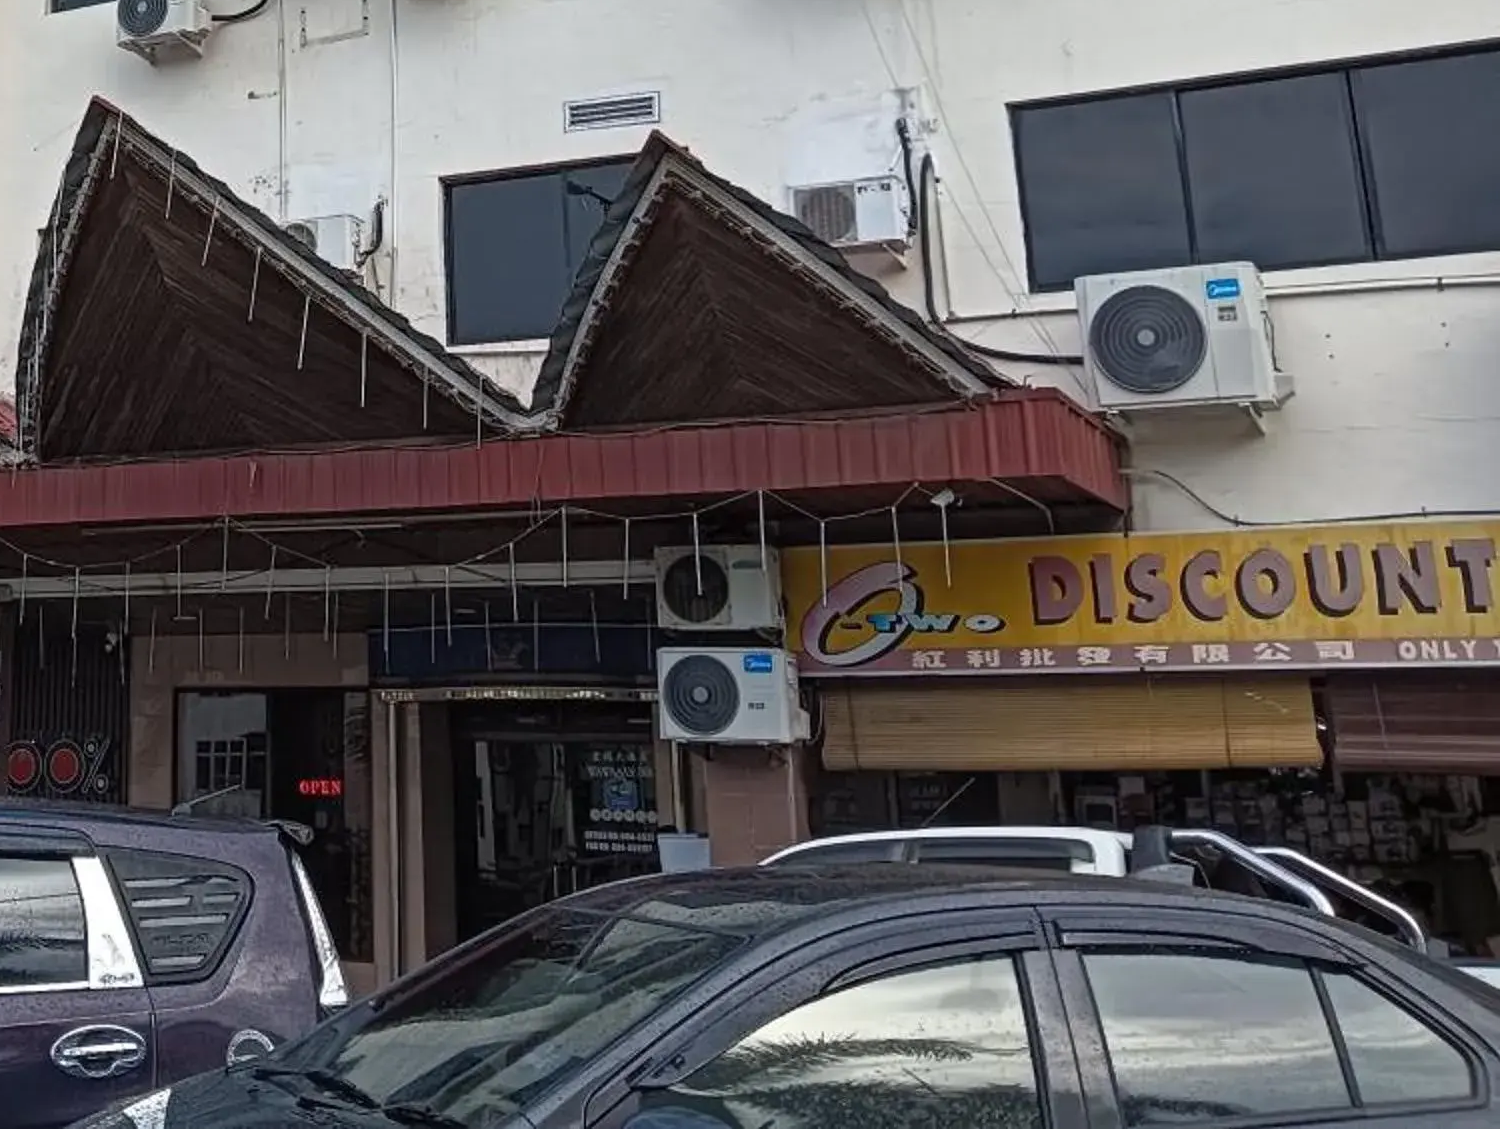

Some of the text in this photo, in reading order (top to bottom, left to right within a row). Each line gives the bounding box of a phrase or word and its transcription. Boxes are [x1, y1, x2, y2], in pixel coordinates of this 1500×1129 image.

[1028, 538, 1497, 626] DISCOUNT
[1398, 640, 1477, 660] ONLY
[299, 779, 341, 795] OPEN
